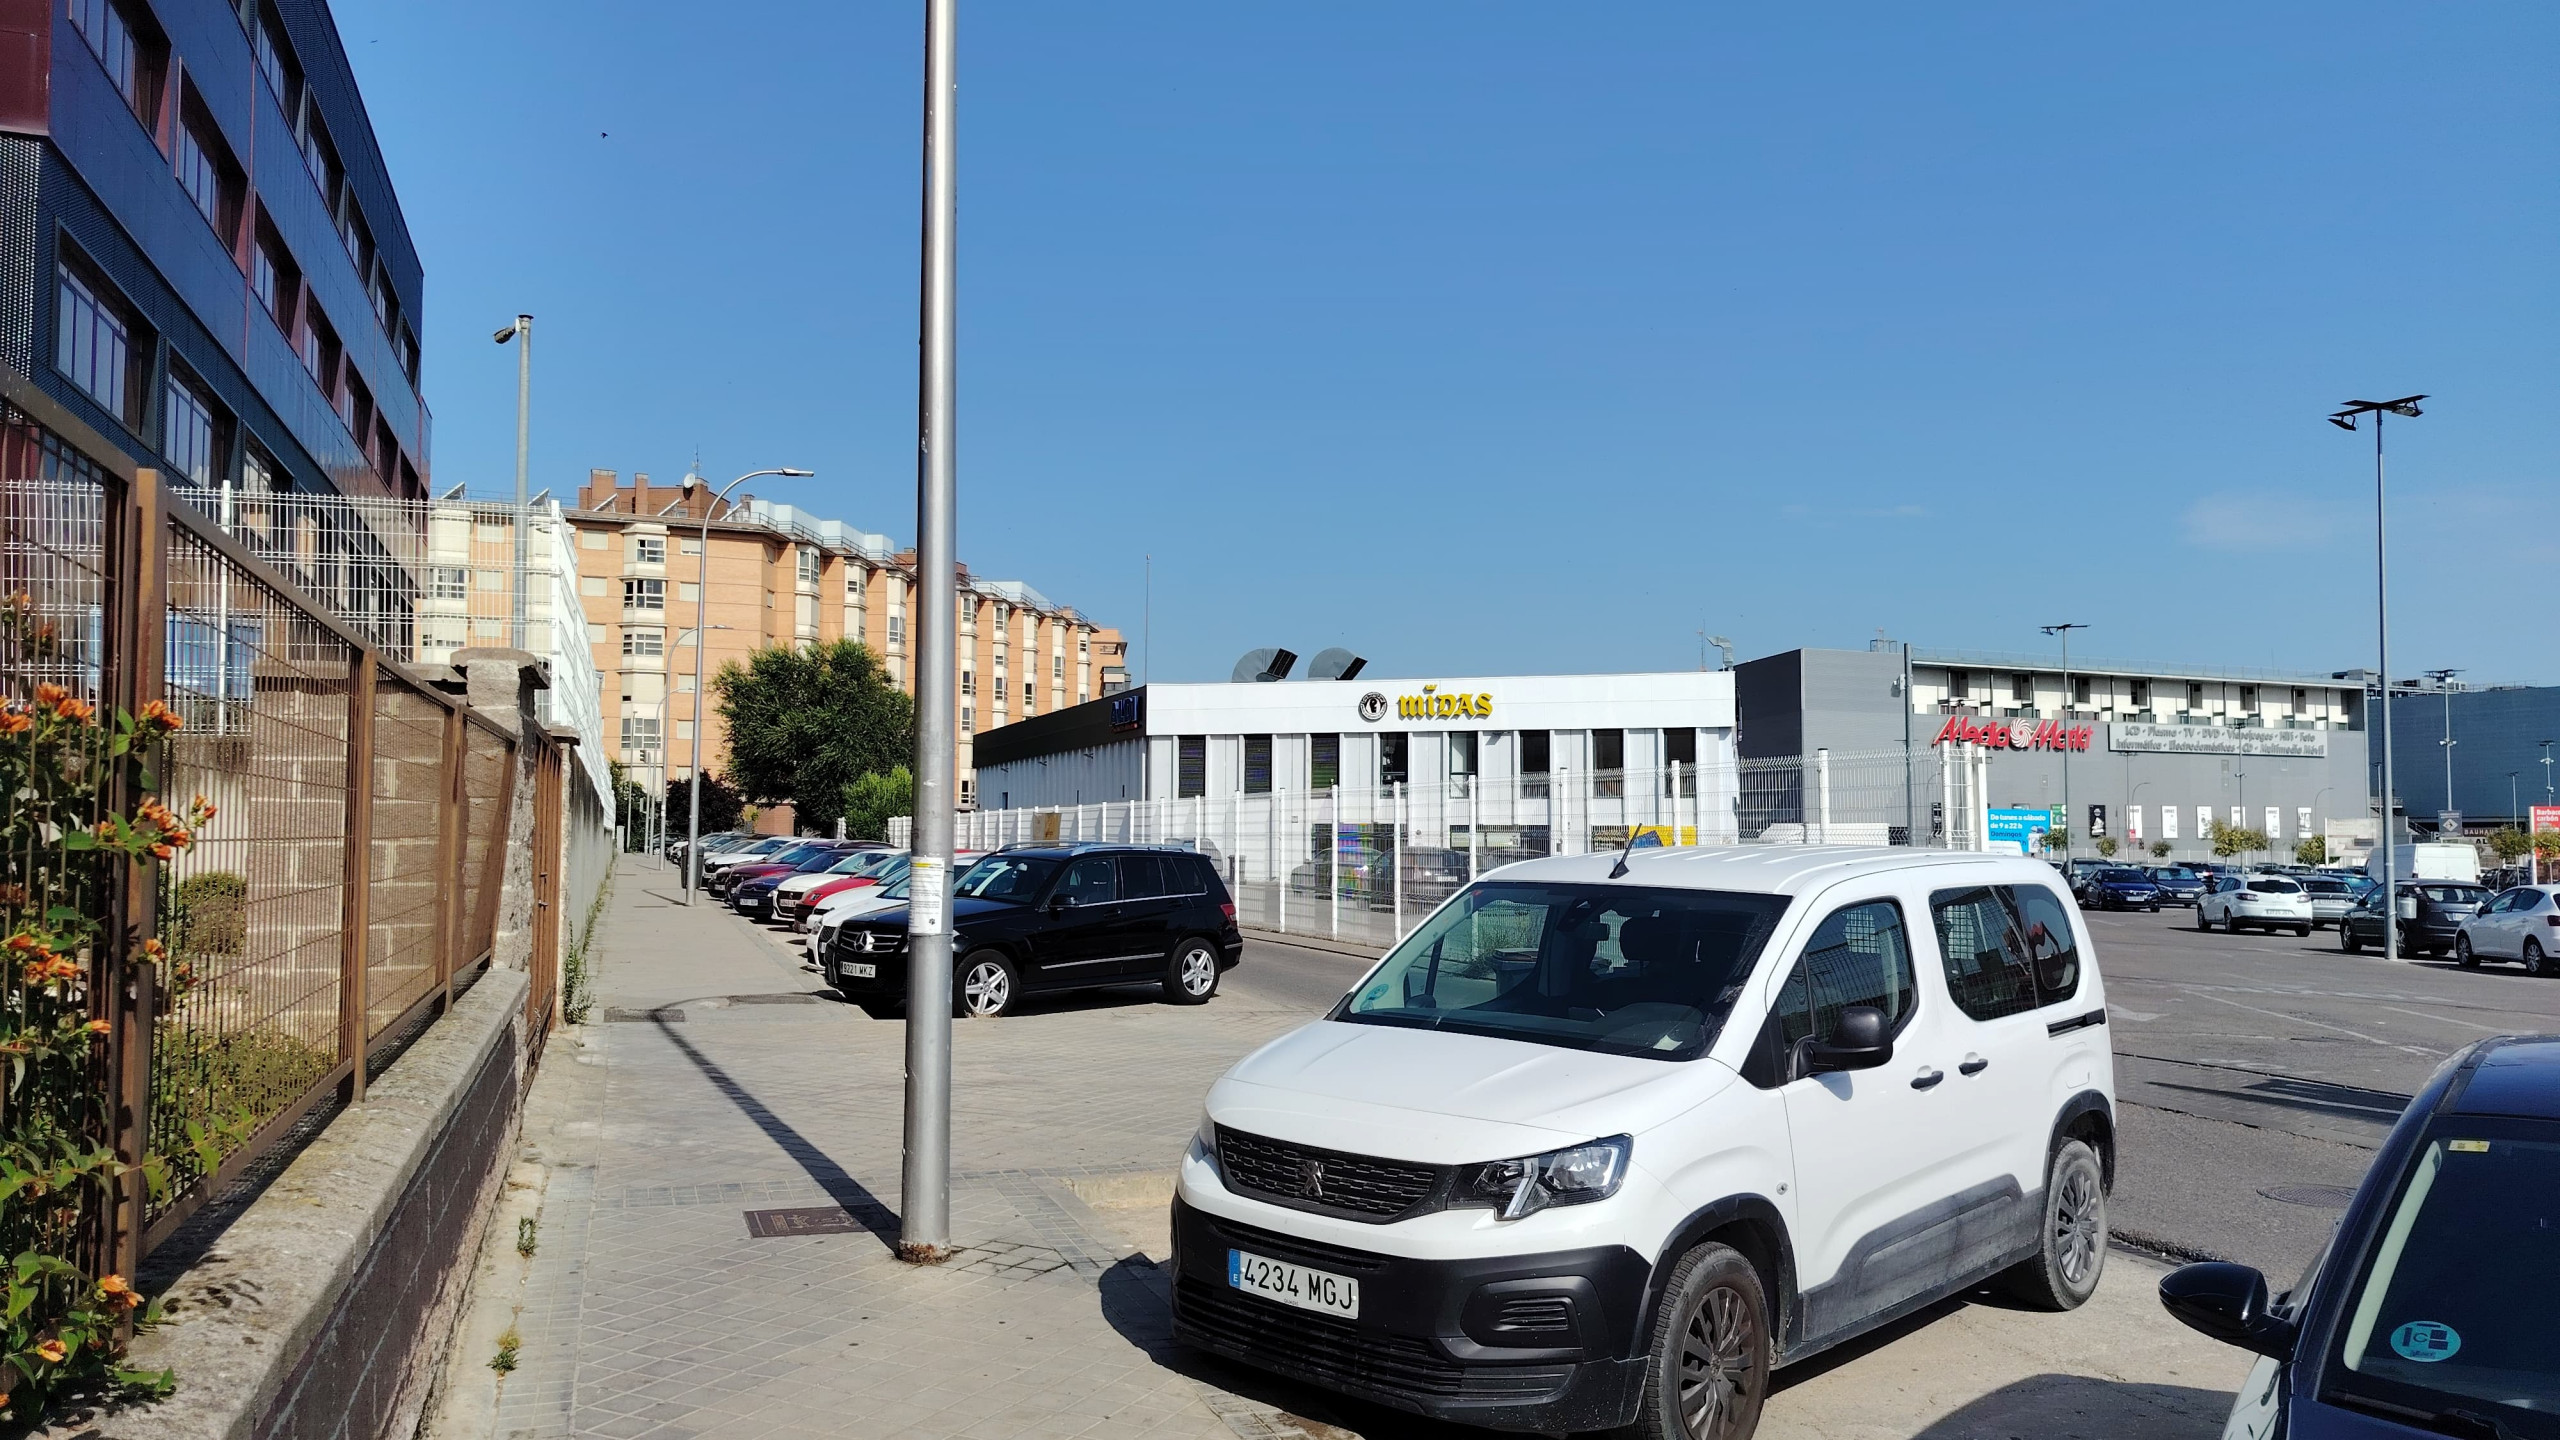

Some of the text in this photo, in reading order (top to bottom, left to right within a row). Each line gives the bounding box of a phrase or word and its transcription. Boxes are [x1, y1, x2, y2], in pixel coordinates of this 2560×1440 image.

[1932, 716, 2094, 749] Media Markt
[2125, 725, 2140, 736] LCD
[2147, 726, 2177, 737] Plasma
[2183, 728, 2195, 738] TV
[2201, 729, 2220, 739] DVD
[2115, 738, 2325, 755] Informática Electrodomésticos CD Multimedia Móvil
[1233, 1273, 1238, 1282] E
[1244, 1258, 1352, 1310] 4234 MGJ
